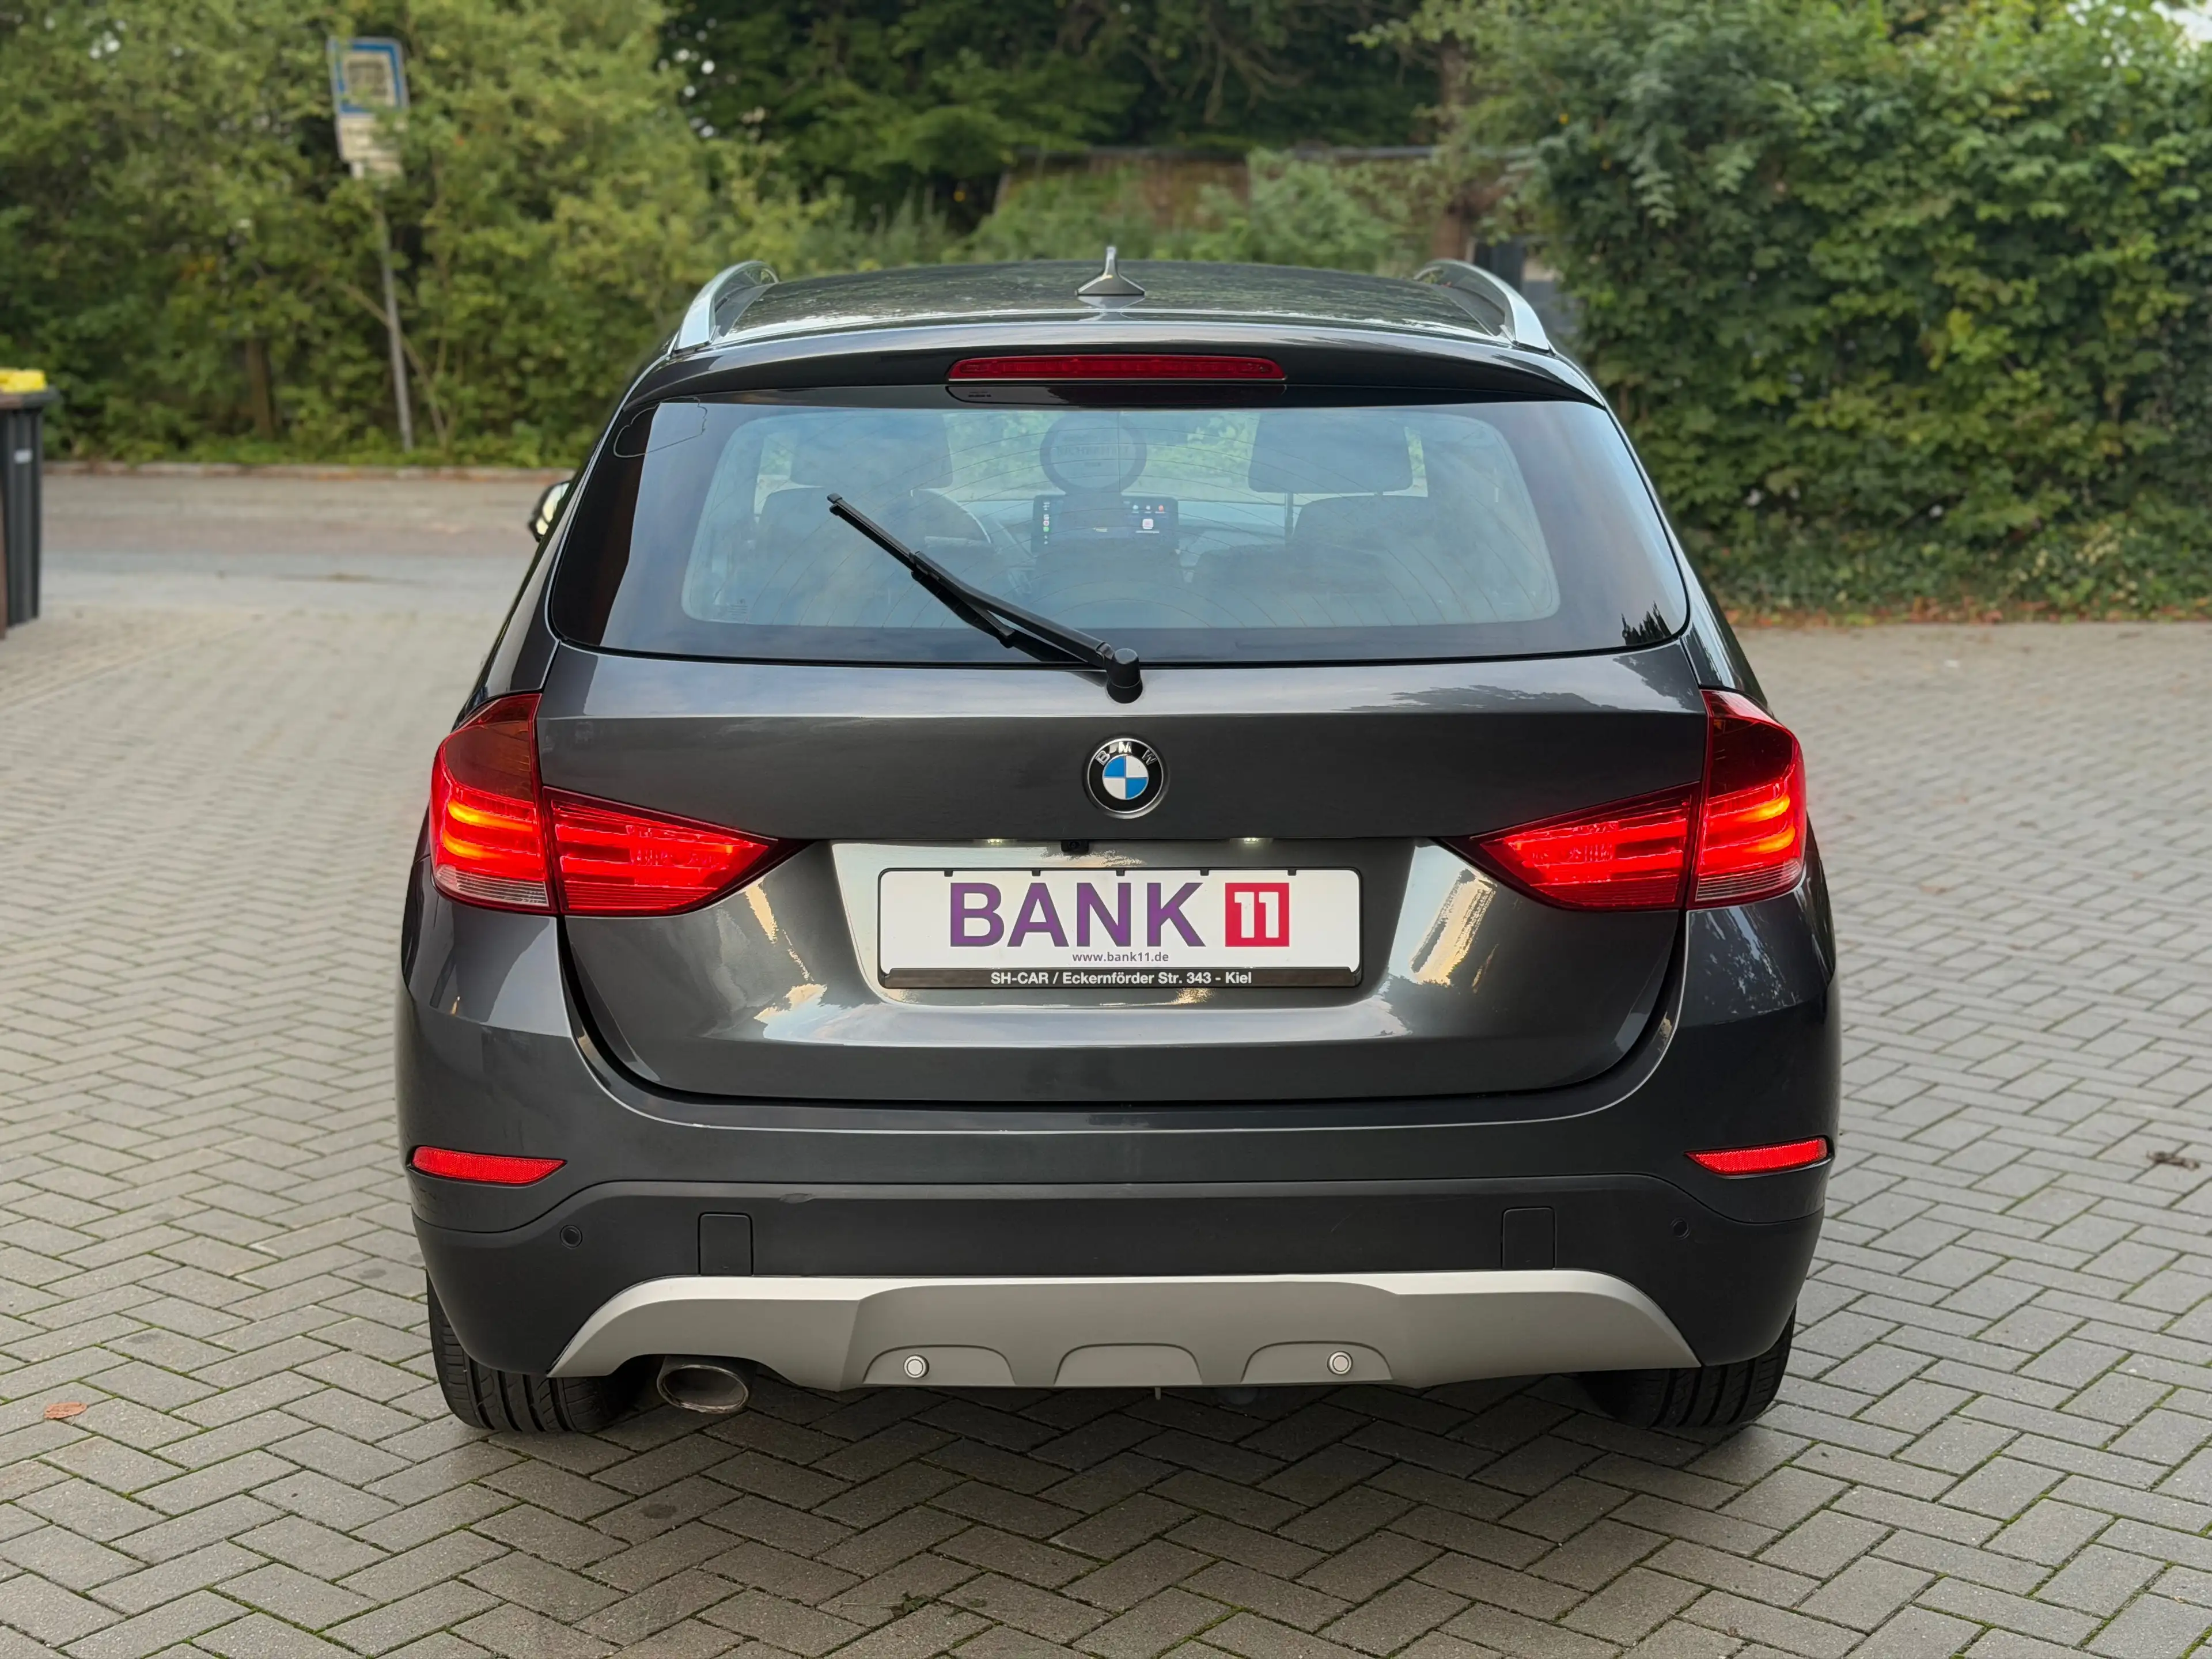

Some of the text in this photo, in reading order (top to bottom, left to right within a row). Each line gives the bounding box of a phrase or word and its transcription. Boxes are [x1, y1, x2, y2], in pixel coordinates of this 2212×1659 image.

[1095, 741, 1157, 766] BMW
[949, 882, 1280, 948] BANK 11
[1072, 951, 1169, 962] www.bank11.de
[990, 972, 1049, 984] SH-CAR
[1063, 972, 1155, 984] Eckernförder
[1158, 972, 1183, 984] Str.
[1186, 971, 1211, 984] 343
[1225, 971, 1252, 984] Kiel
